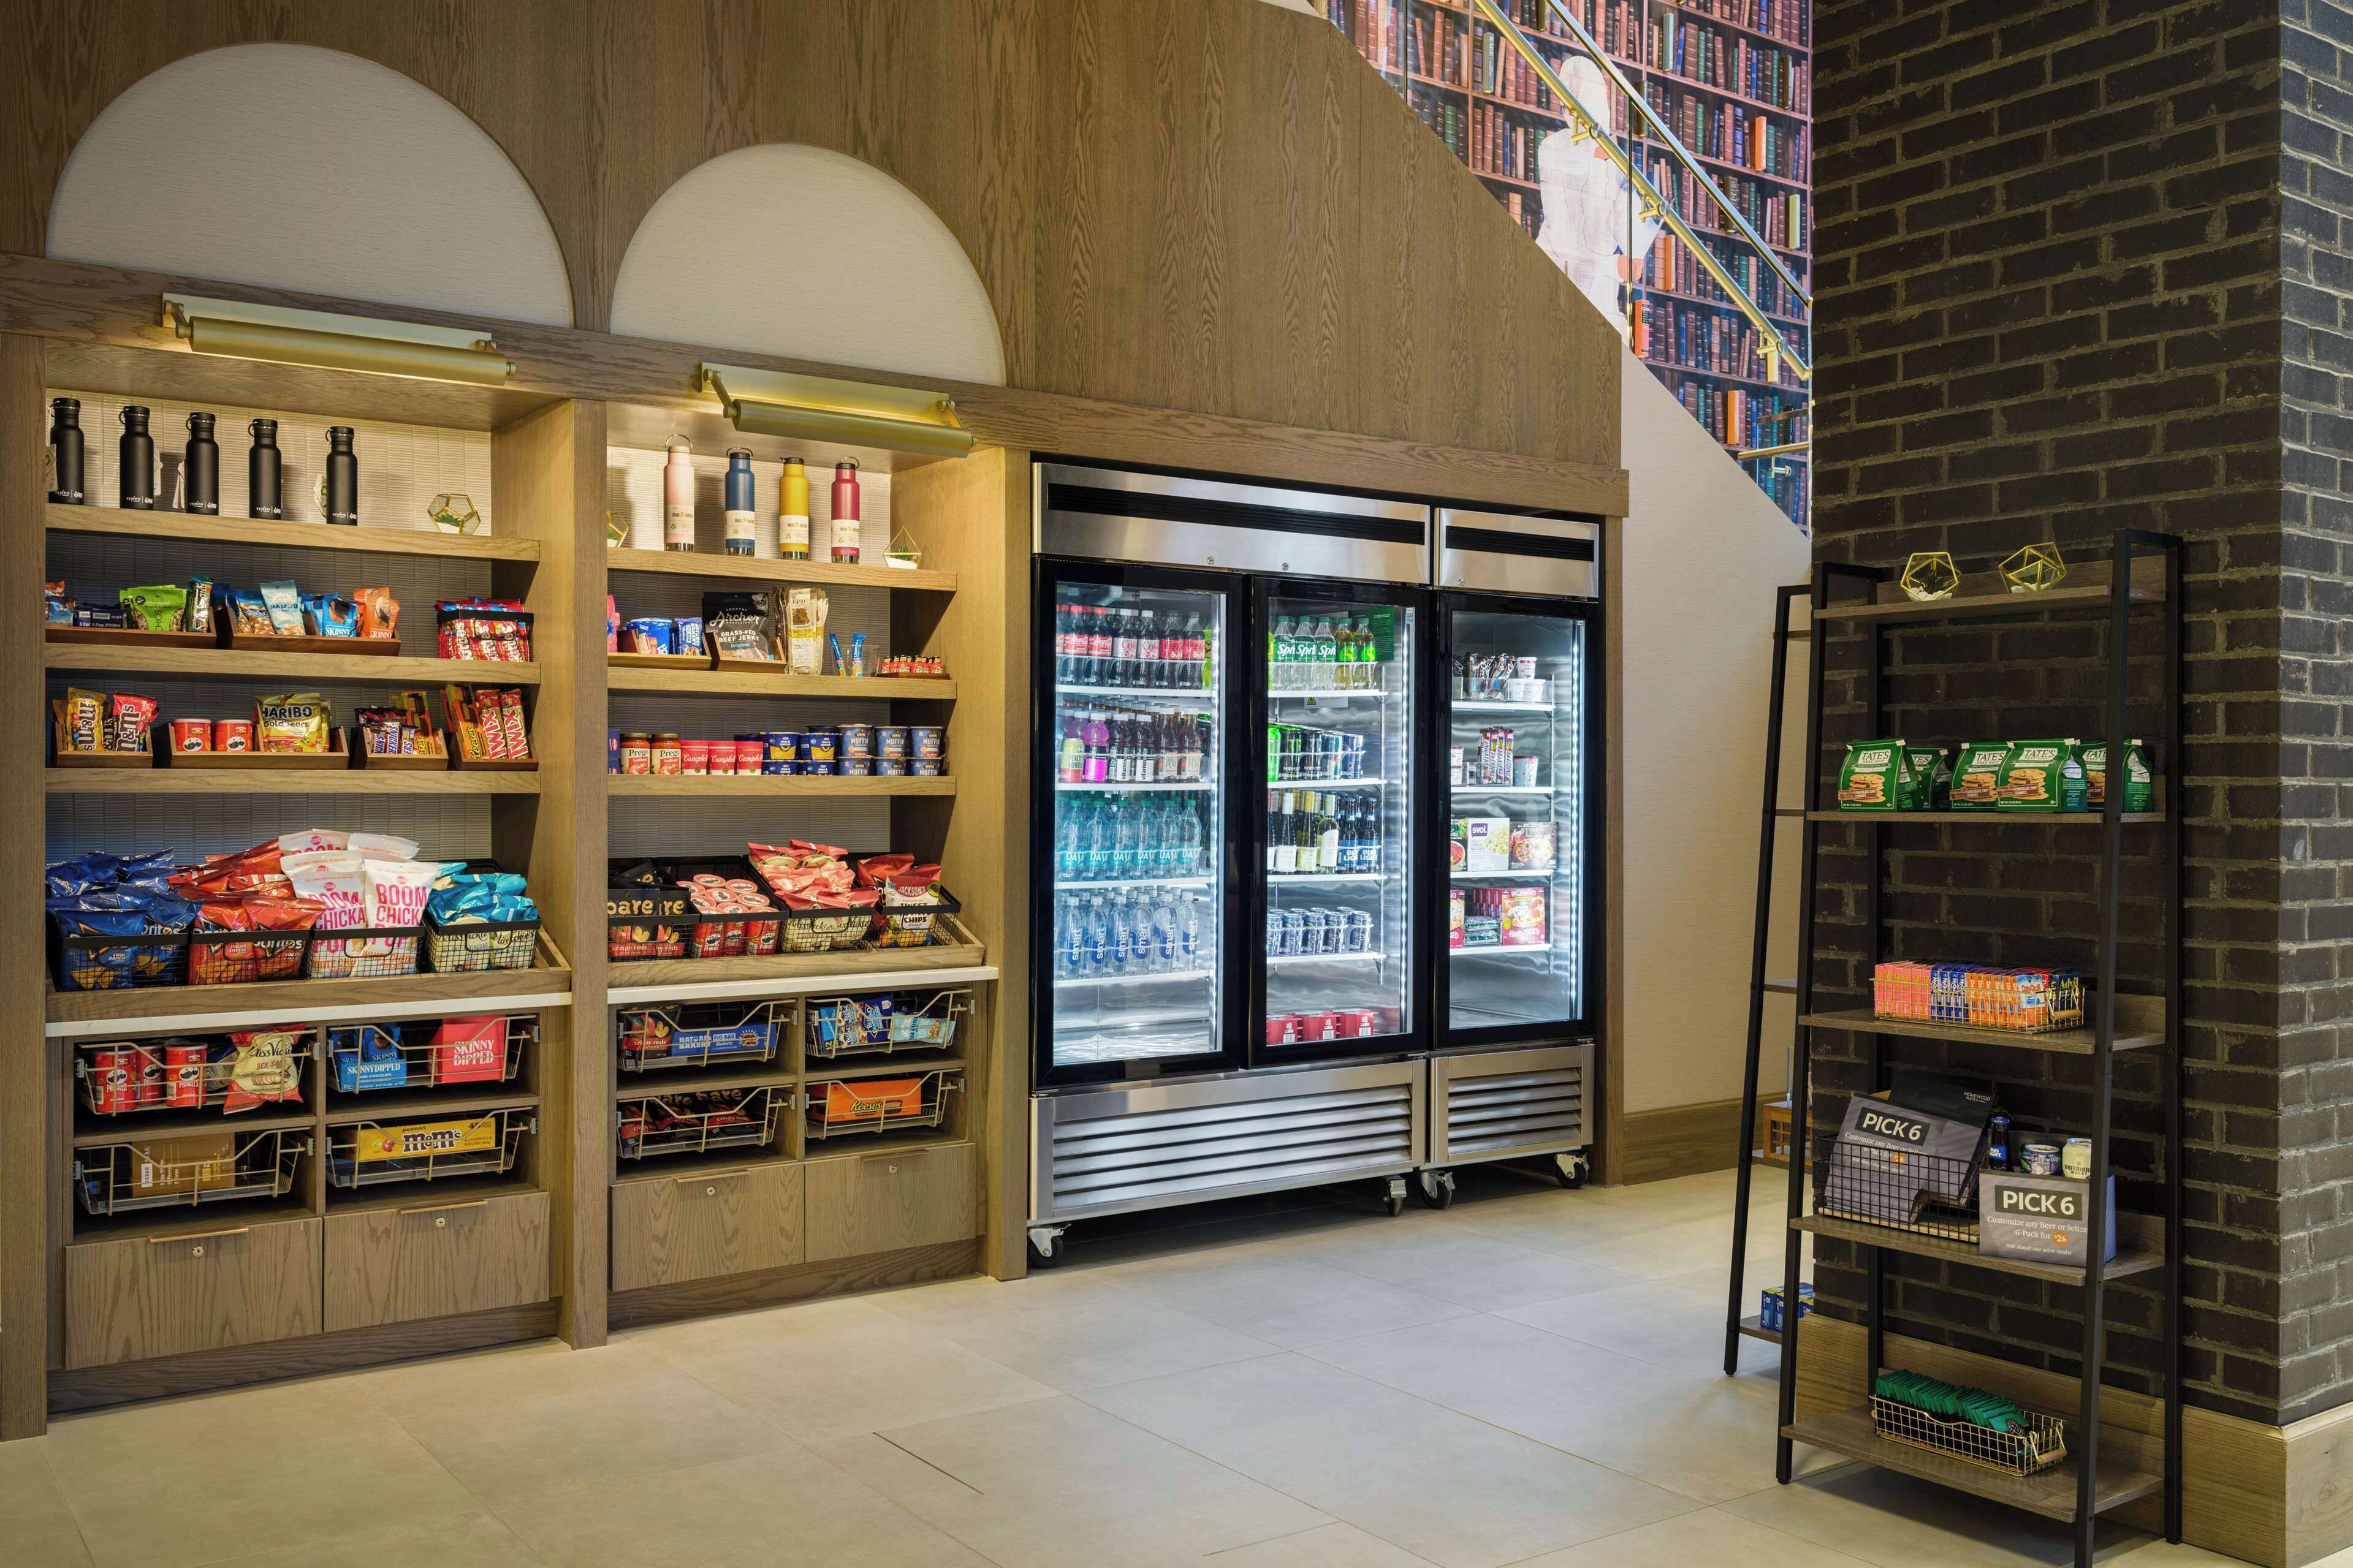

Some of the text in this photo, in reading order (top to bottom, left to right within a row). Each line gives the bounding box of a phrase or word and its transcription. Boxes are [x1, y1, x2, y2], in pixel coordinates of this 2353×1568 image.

[710, 611, 759, 627] Archer
[325, 627, 351, 635] SKINNY
[370, 630, 392, 638] SKINNY
[262, 706, 312, 719] HARIBO
[389, 726, 398, 754] SNICKER
[466, 727, 481, 758] Reese's
[482, 710, 506, 759] TWIX
[504, 711, 528, 759] TWIX
[1862, 751, 1889, 760] TATE'S
[1976, 751, 2005, 761] TATE'S
[376, 884, 427, 907] BOOM
[898, 887, 926, 896] JACKSON'S
[315, 906, 366, 930] CHICKA
[376, 906, 424, 926] CHICK
[1097, 926, 1107, 959] smart
[1118, 925, 1128, 958] smart
[1138, 923, 1149, 955] smart
[1165, 924, 1175, 955] smart
[1188, 919, 1198, 950] smart
[1072, 928, 1082, 961] smart
[2059, 976, 2079, 990] Advil
[454, 1039, 495, 1055] SKINNY
[373, 1051, 397, 1061] SKINNY
[454, 1050, 493, 1066] DIPPED
[348, 1064, 400, 1074] SKNNYDIPPED
[179, 1080, 199, 1089] PRINGLES
[1964, 1091, 1990, 1101] HOMEWOOD
[850, 1100, 883, 1112] Reese's
[1862, 1113, 1922, 1141] PICK 6
[1845, 1132, 1874, 1144] Customize
[1887, 1142, 1900, 1151] Beer
[1863, 1147, 1882, 1157] 6-Pack
[2003, 1191, 2075, 1215] PICK 6
[1987, 1216, 2024, 1226] Customize
[2067, 1224, 2088, 1233] Seltze
[2015, 1229, 2039, 1238] 6-Pack
